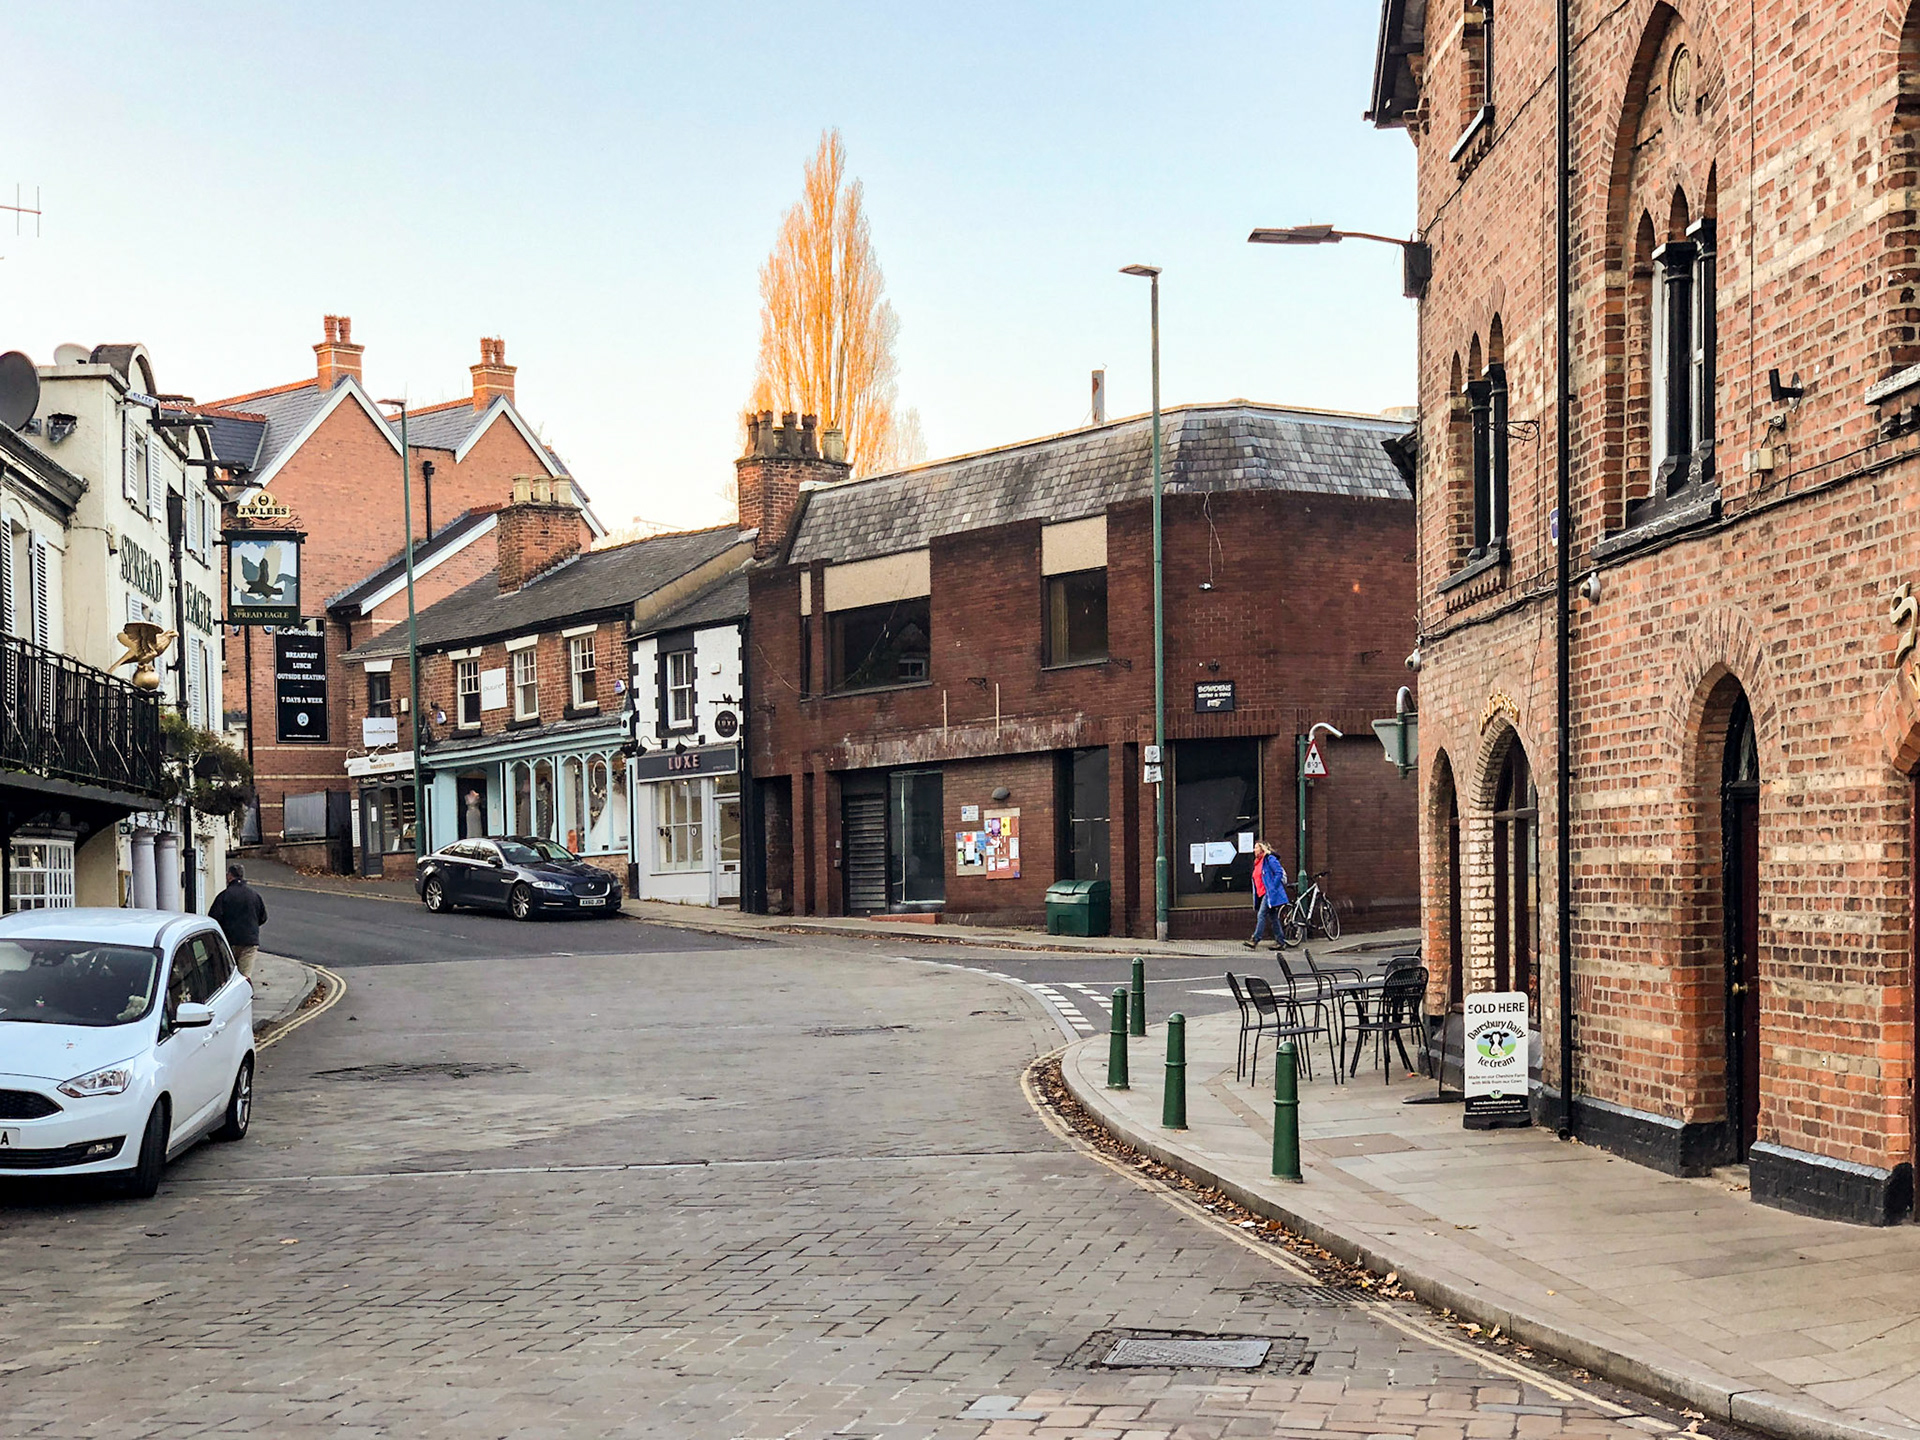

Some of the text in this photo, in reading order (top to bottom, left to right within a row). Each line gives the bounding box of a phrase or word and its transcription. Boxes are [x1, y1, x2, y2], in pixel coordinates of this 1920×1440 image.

[120, 534, 162, 603] SPREAD
[185, 581, 212, 636] EAGLE
[668, 755, 699, 770] LUXE
[1468, 1002, 1525, 1014] SOLD HERE
[1467, 1020, 1526, 1040] Daresbury Dairy
[1478, 1056, 1516, 1068] Ice Cream
[0, 1131, 9, 1145] A
